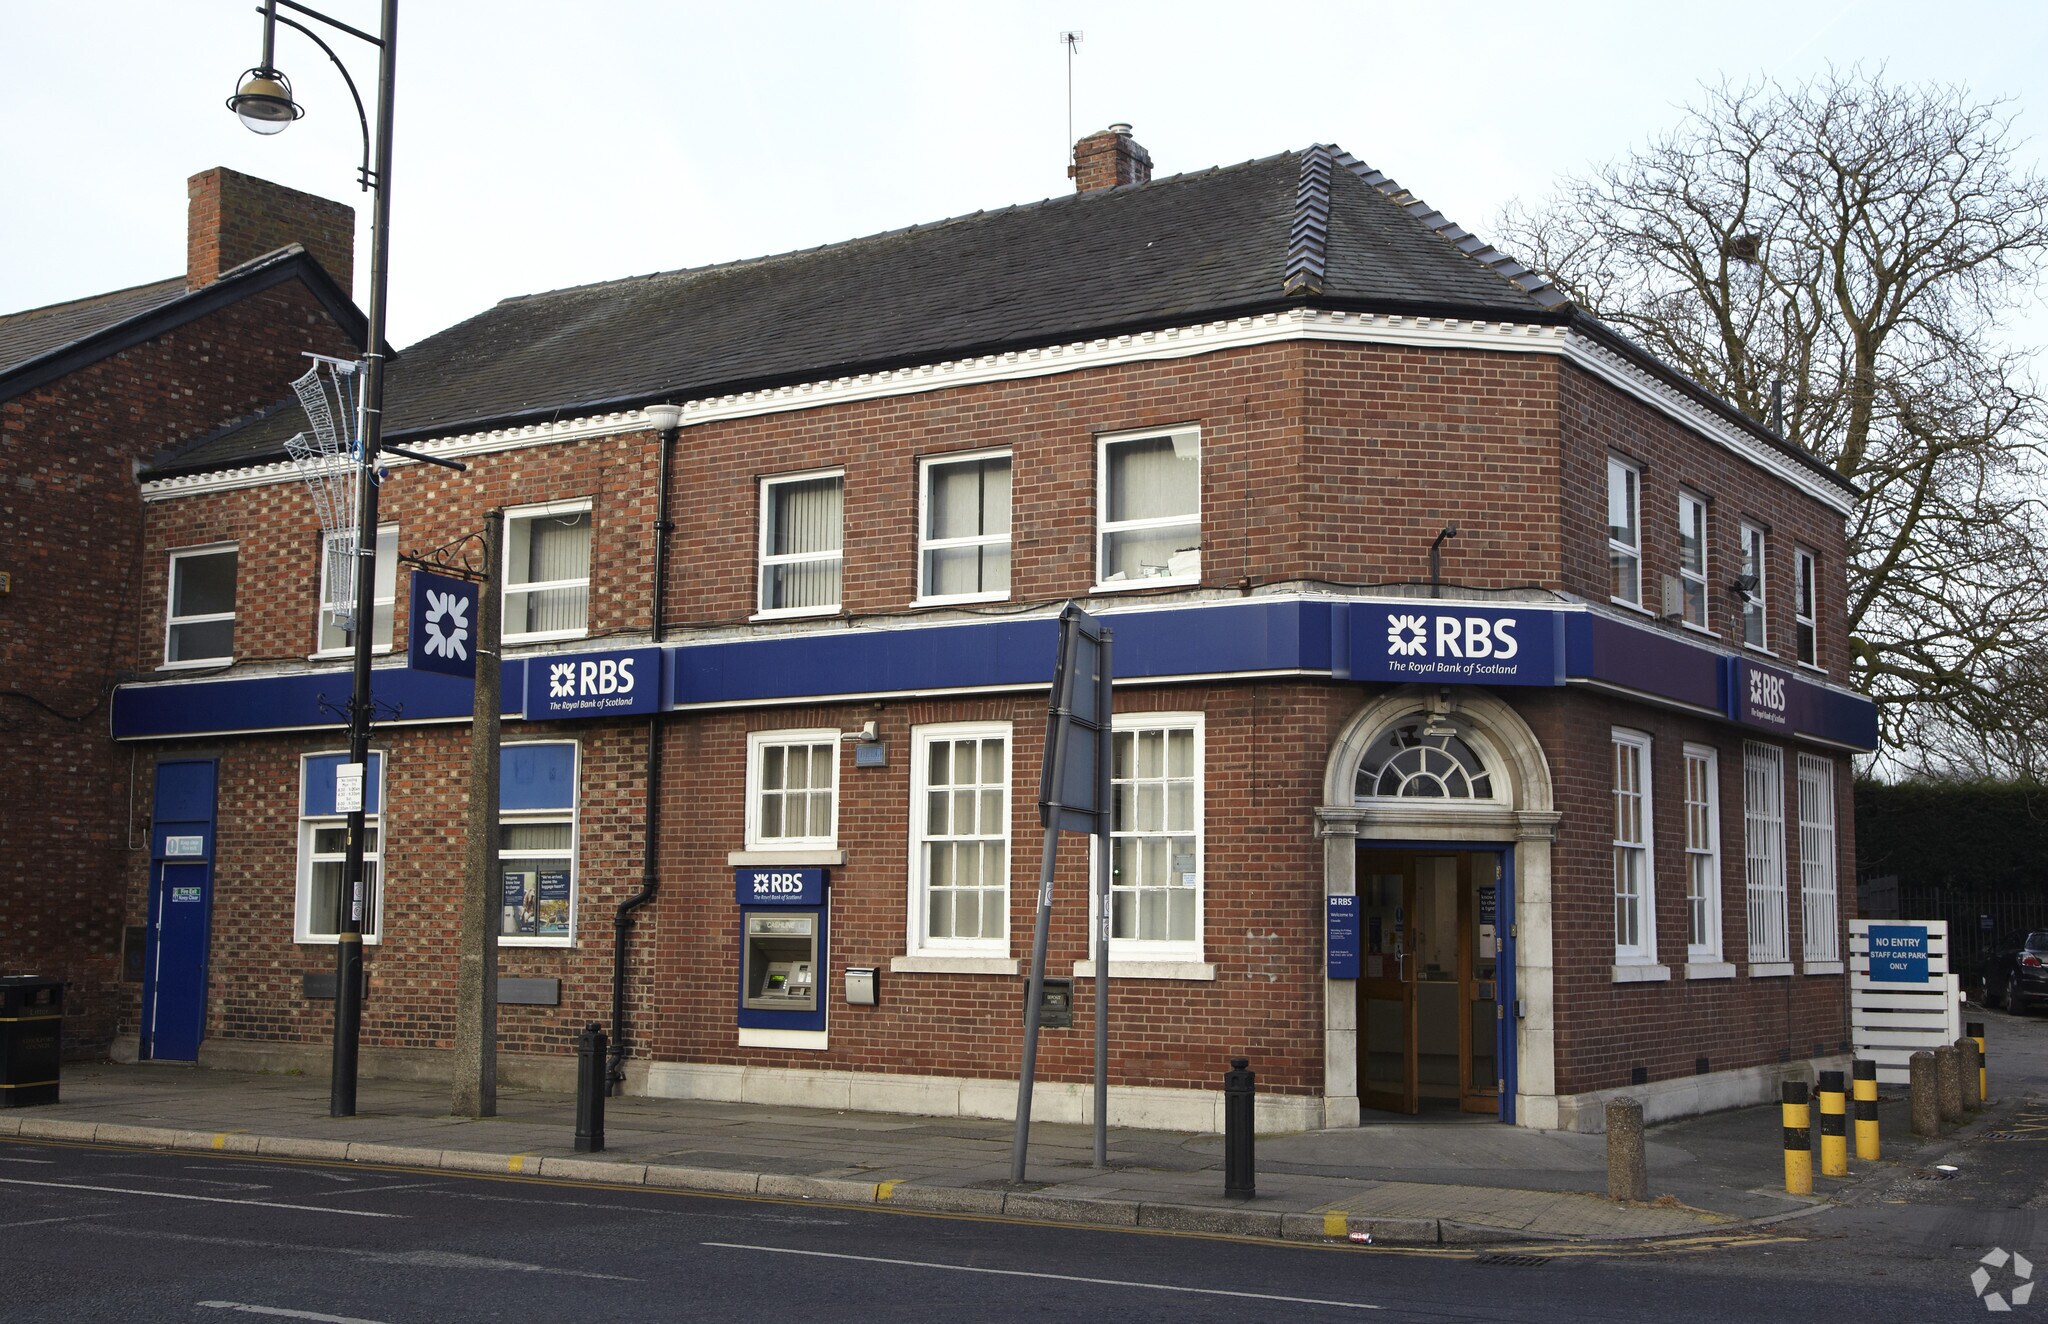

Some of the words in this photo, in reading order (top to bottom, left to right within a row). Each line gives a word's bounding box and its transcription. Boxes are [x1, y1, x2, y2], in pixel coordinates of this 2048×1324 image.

[1436, 616, 1518, 659] RBS
[580, 658, 634, 695] RBS
[1389, 661, 1406, 671] The
[1409, 662, 1435, 674] Royal
[1437, 663, 1461, 672] Bank
[1463, 663, 1475, 676] of
[1476, 664, 1517, 675] Scotland
[1763, 673, 1785, 711] RBS
[550, 702, 561, 710] The
[562, 701, 580, 711] Royal
[580, 700, 596, 708] Bank
[597, 698, 605, 709] of
[605, 697, 633, 707] Scotland
[771, 873, 803, 893] RBS
[1338, 897, 1352, 906] RBS
[1876, 938, 1889, 946] NO
[1891, 938, 1920, 947] ENTRY
